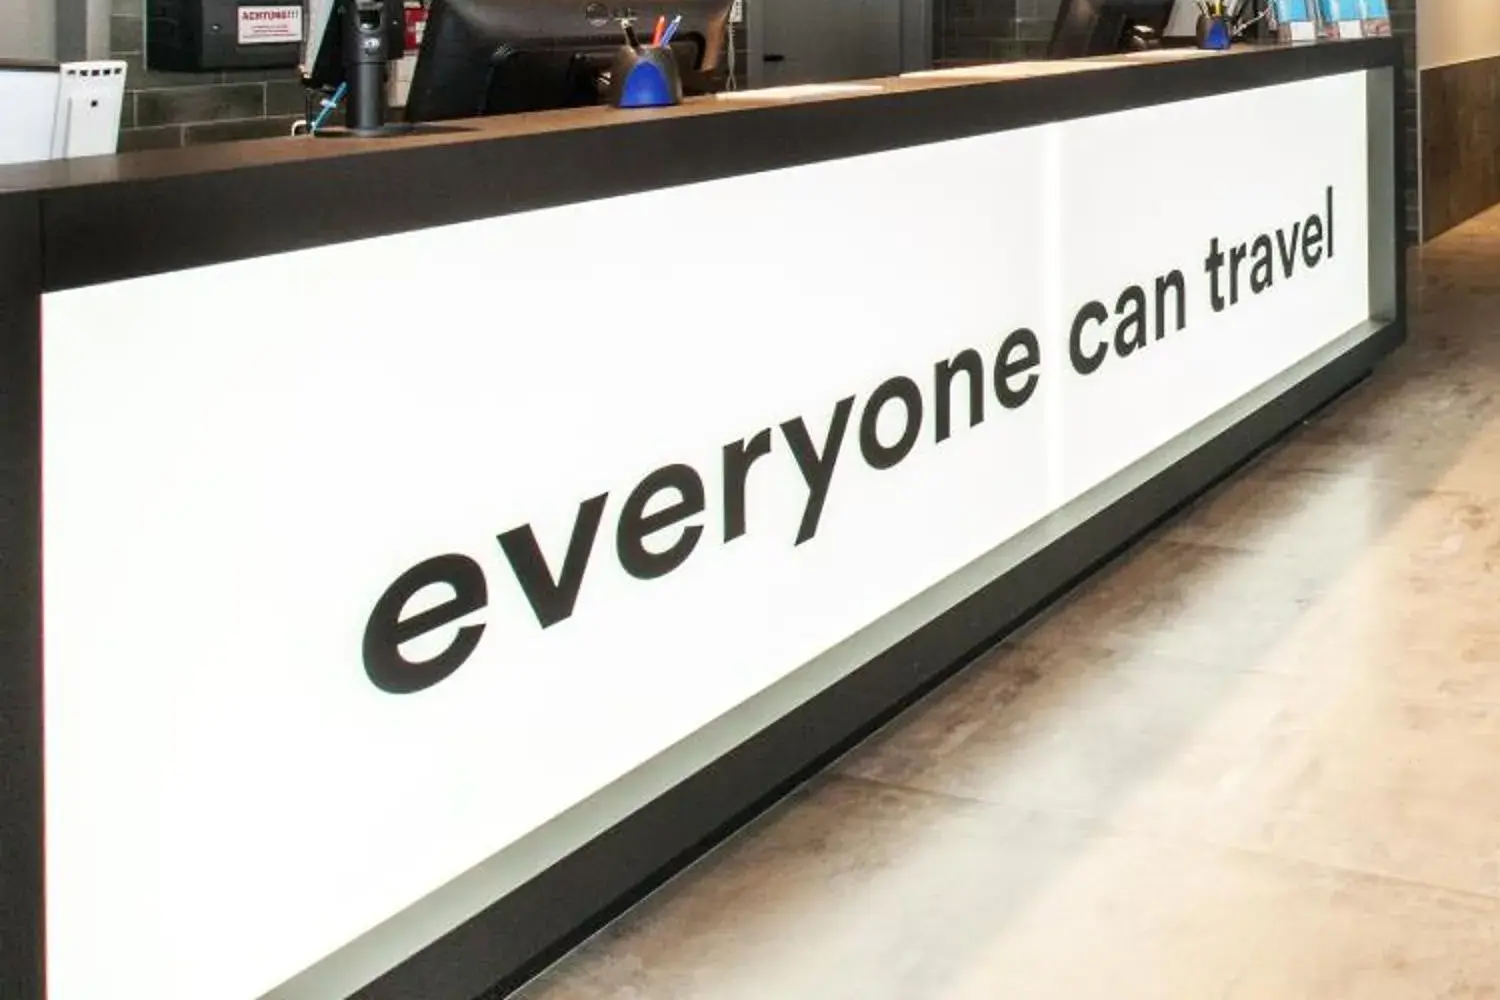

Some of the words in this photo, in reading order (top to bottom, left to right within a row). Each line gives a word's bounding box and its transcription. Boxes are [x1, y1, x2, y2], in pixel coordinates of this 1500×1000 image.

[361, 326, 1041, 694] everyone
[1069, 269, 1187, 374] can
[1205, 186, 1335, 312] travel
